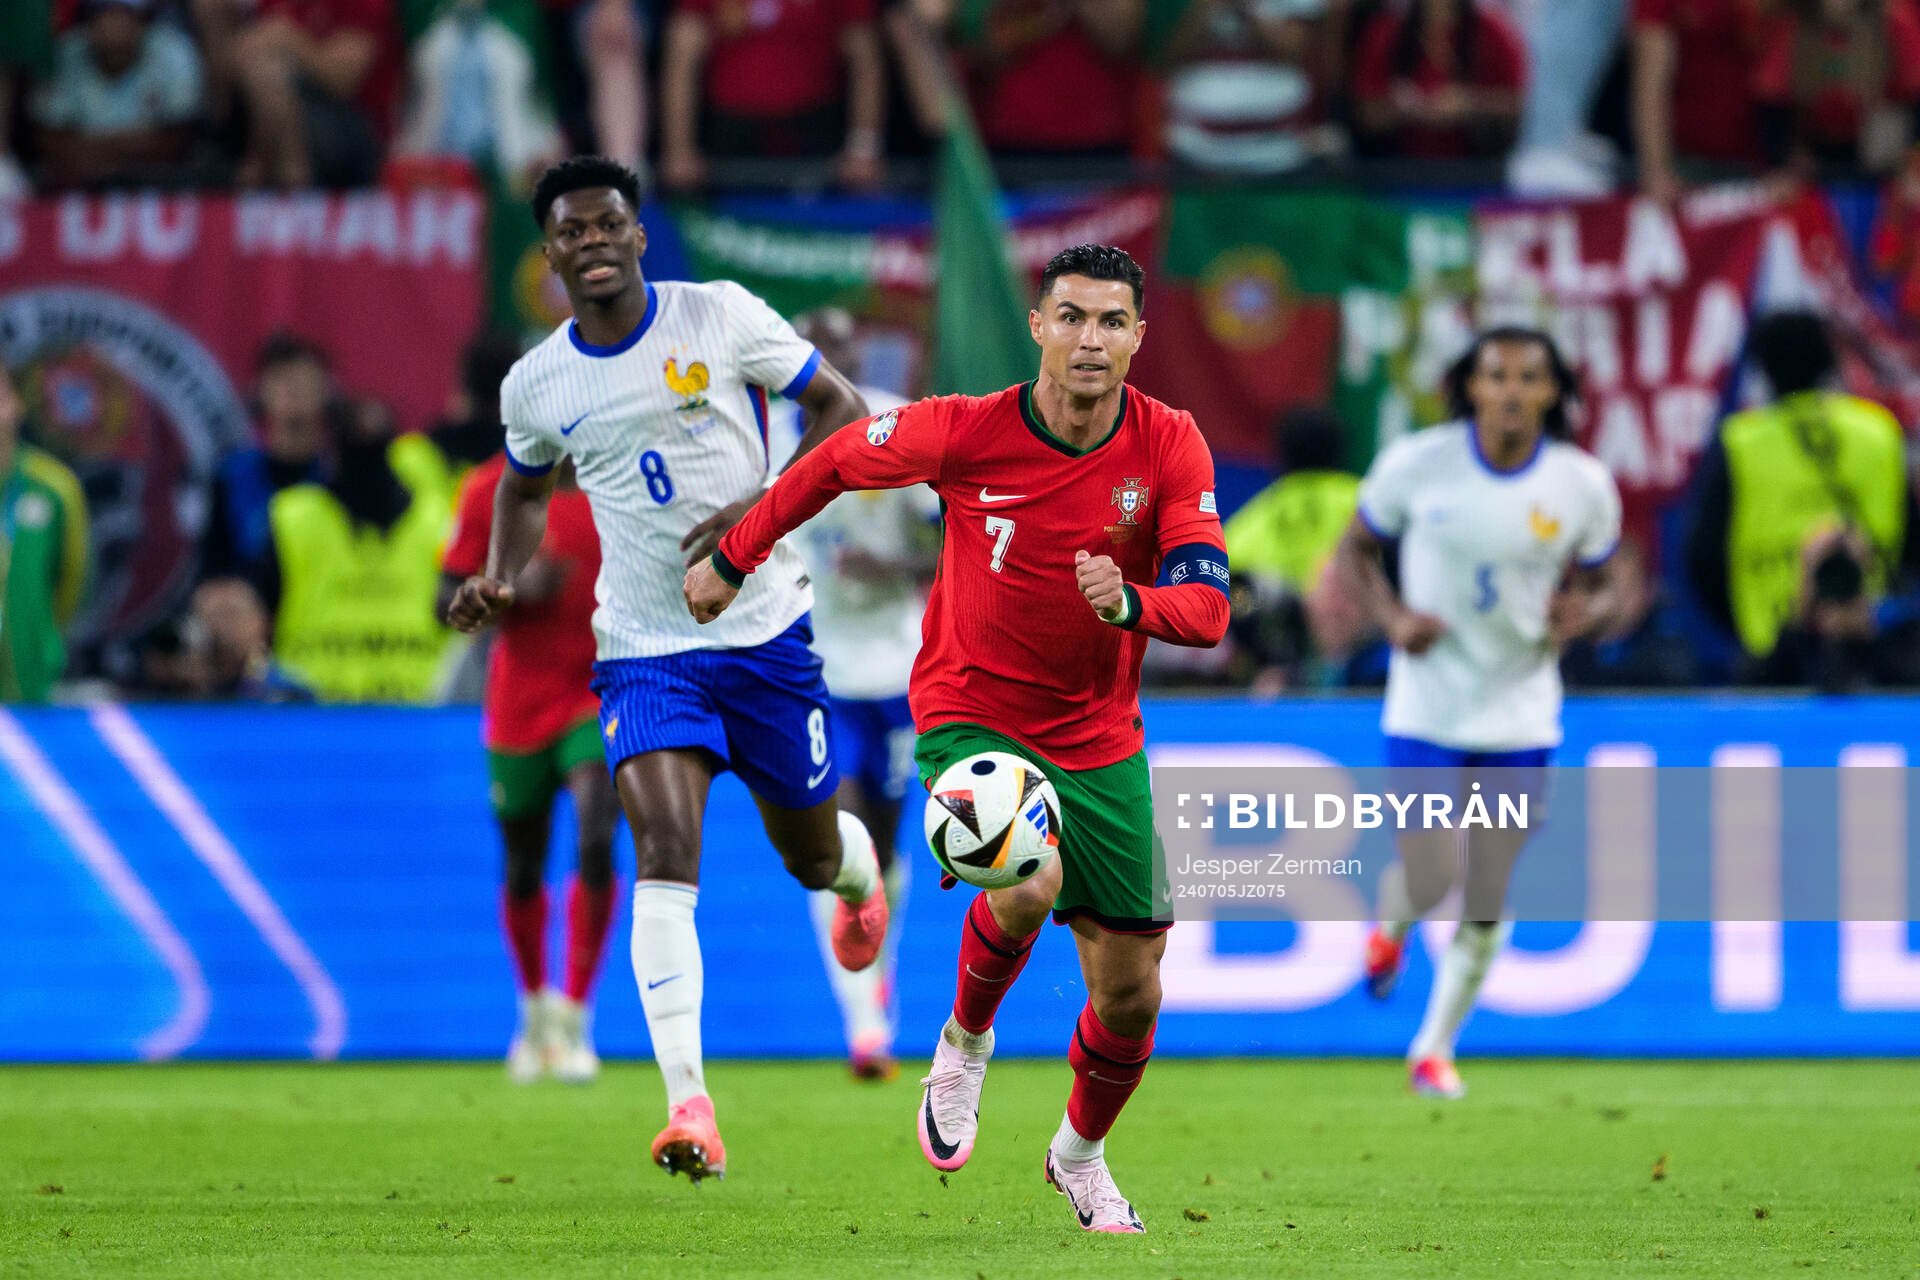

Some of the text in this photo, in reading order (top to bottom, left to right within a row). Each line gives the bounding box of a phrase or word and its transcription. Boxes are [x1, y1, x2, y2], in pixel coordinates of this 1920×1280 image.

[640, 450, 673, 505] 8
[985, 515, 1015, 574] 7
[807, 707, 828, 767] 8
